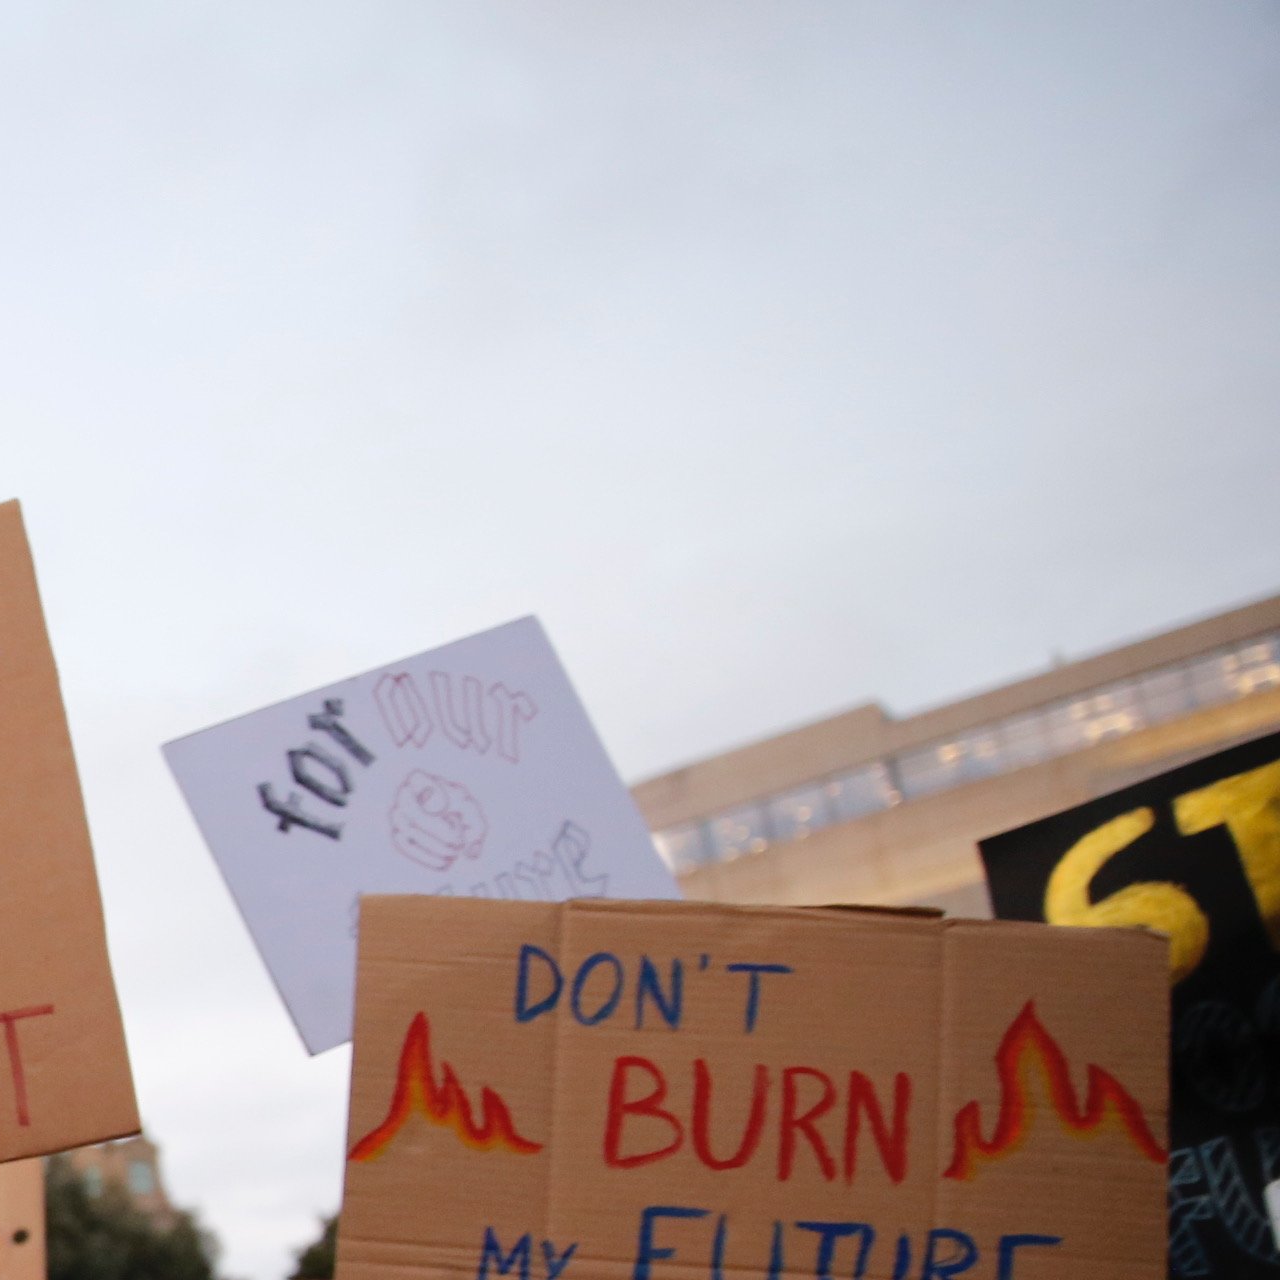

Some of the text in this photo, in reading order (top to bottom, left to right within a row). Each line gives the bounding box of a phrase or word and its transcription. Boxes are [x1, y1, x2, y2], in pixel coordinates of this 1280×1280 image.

[257, 697, 376, 841] for
[513, 943, 794, 1034] DON'T
[603, 1054, 912, 1186] BURN
